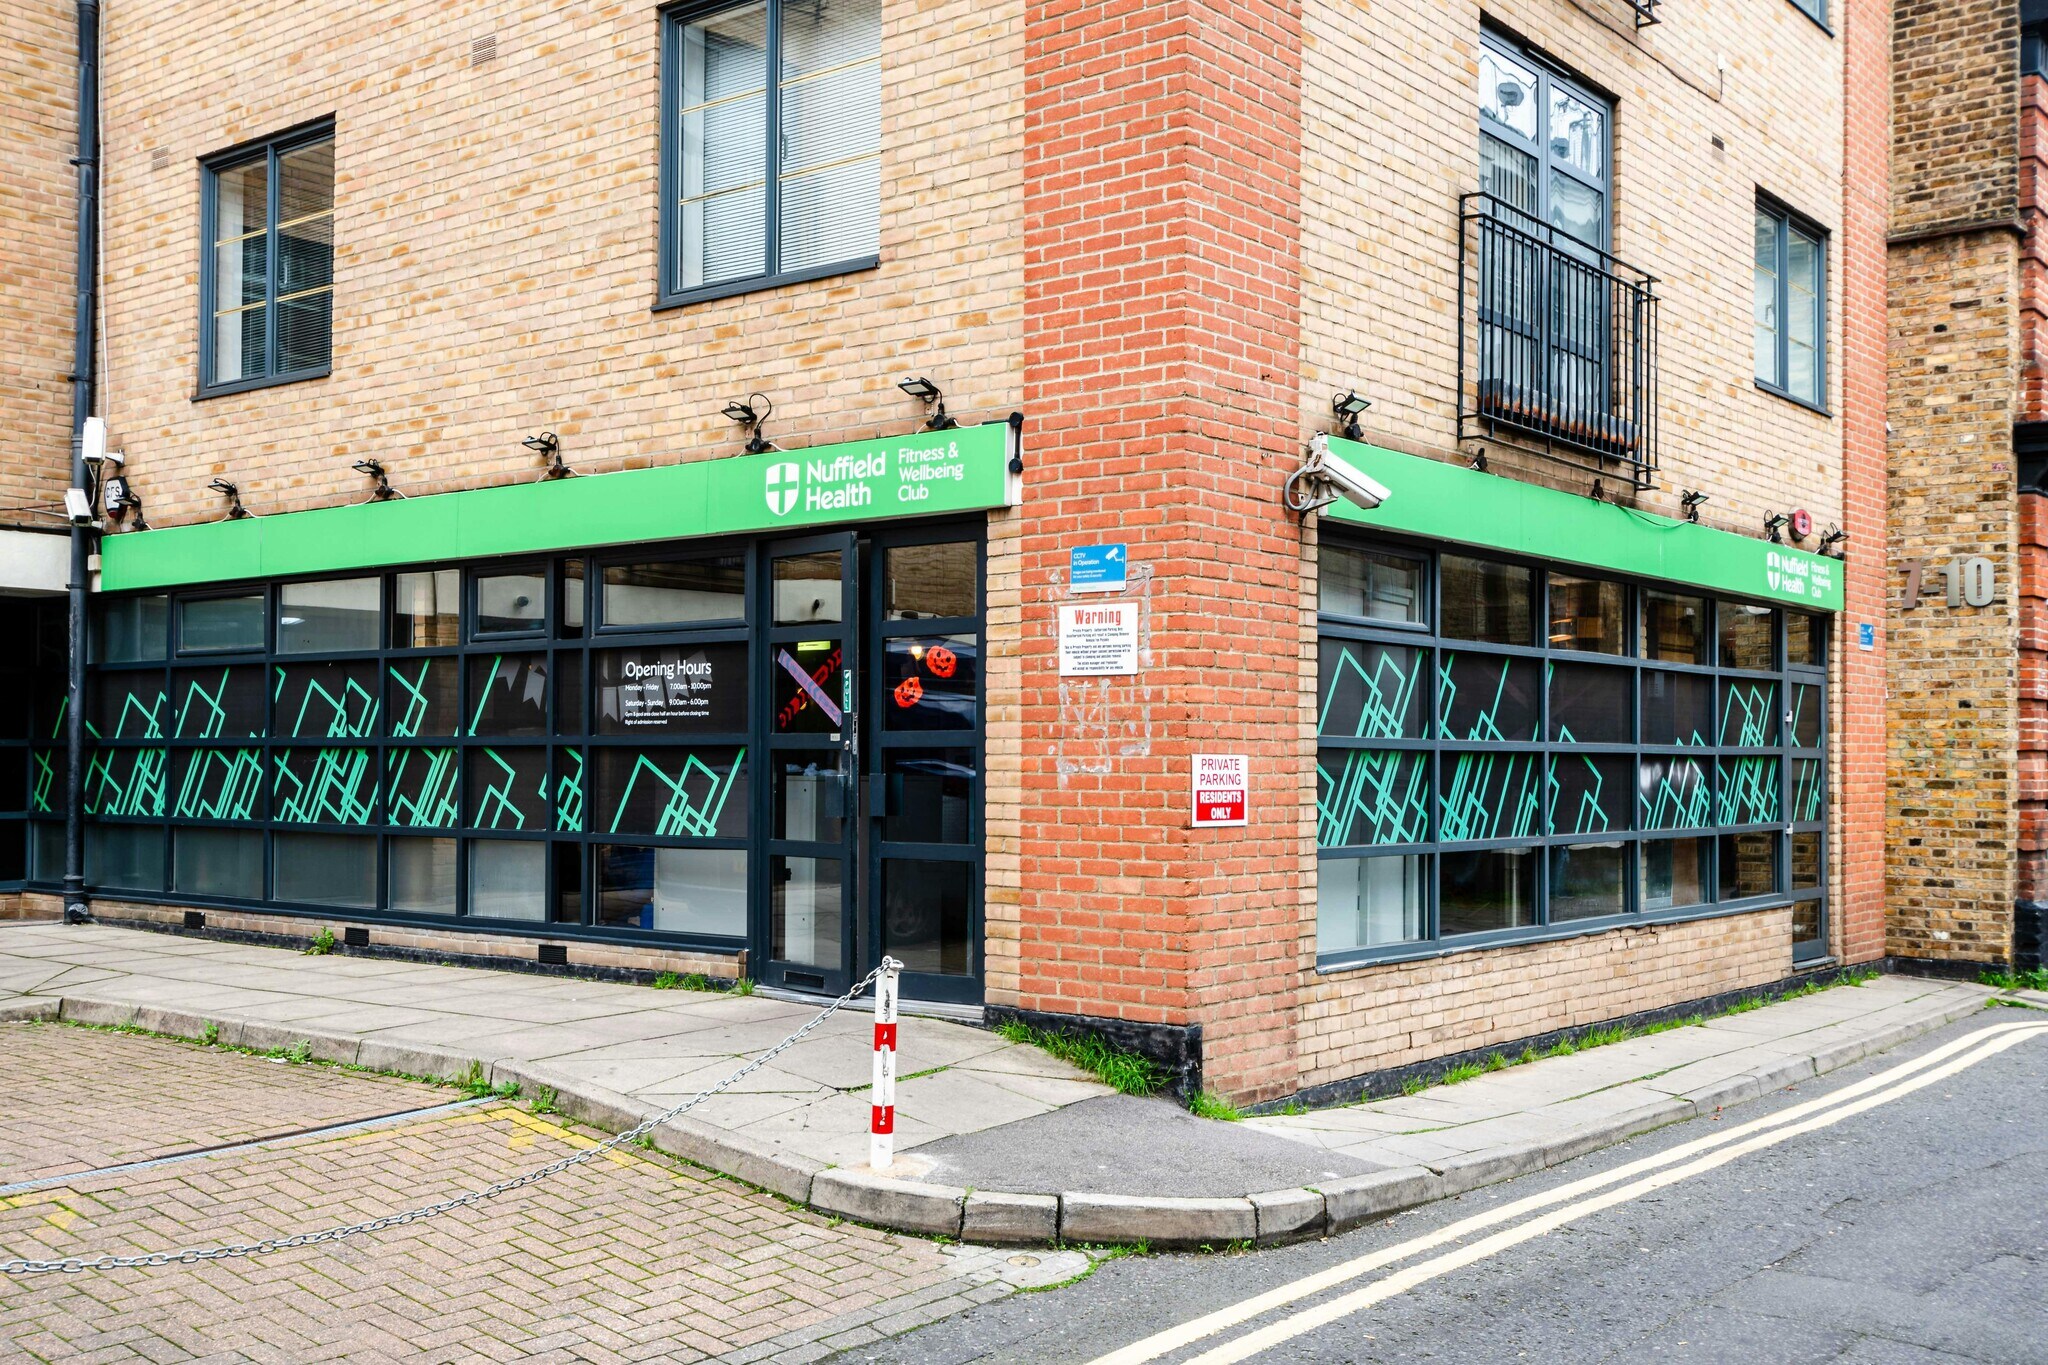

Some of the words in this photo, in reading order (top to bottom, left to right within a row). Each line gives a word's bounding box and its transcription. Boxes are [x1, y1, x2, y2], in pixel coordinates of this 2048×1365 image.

[898, 448, 945, 464] Fitness
[948, 442, 959, 458] &
[807, 451, 886, 484] Nuffield
[899, 463, 964, 482] Wellbeing
[806, 482, 871, 511] Health
[898, 484, 929, 502] Club
[1782, 556, 1808, 577] Nuffield
[1782, 574, 1804, 595] Health
[1898, 557, 1994, 610] 7-10
[1075, 609, 1121, 626] Warning
[625, 661, 674, 680] Opening
[677, 660, 711, 675] Hours
[646, 683, 659, 691] Friday
[1201, 759, 1240, 770] PRIVATE
[1200, 774, 1241, 785] PARKING
[1200, 791, 1242, 804] RESIDENTS
[1211, 807, 1231, 819] ONLY
